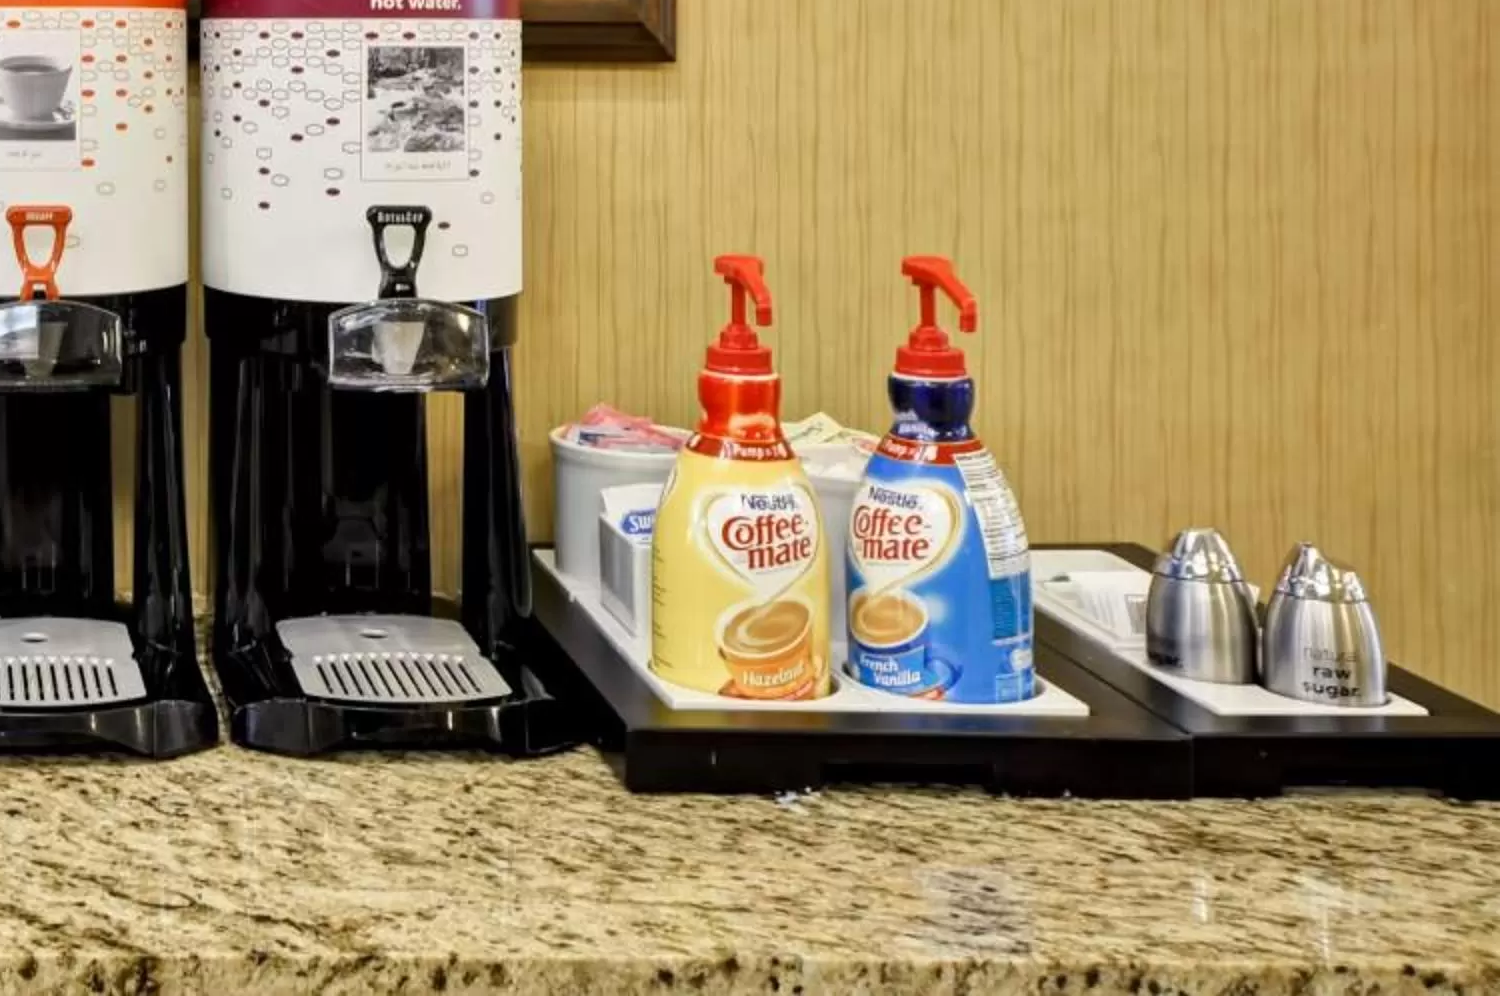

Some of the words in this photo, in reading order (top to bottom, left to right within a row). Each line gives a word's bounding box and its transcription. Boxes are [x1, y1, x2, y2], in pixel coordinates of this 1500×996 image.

[748, 536, 811, 570] mate
[863, 538, 929, 560] mate
[1312, 666, 1351, 680] raw
